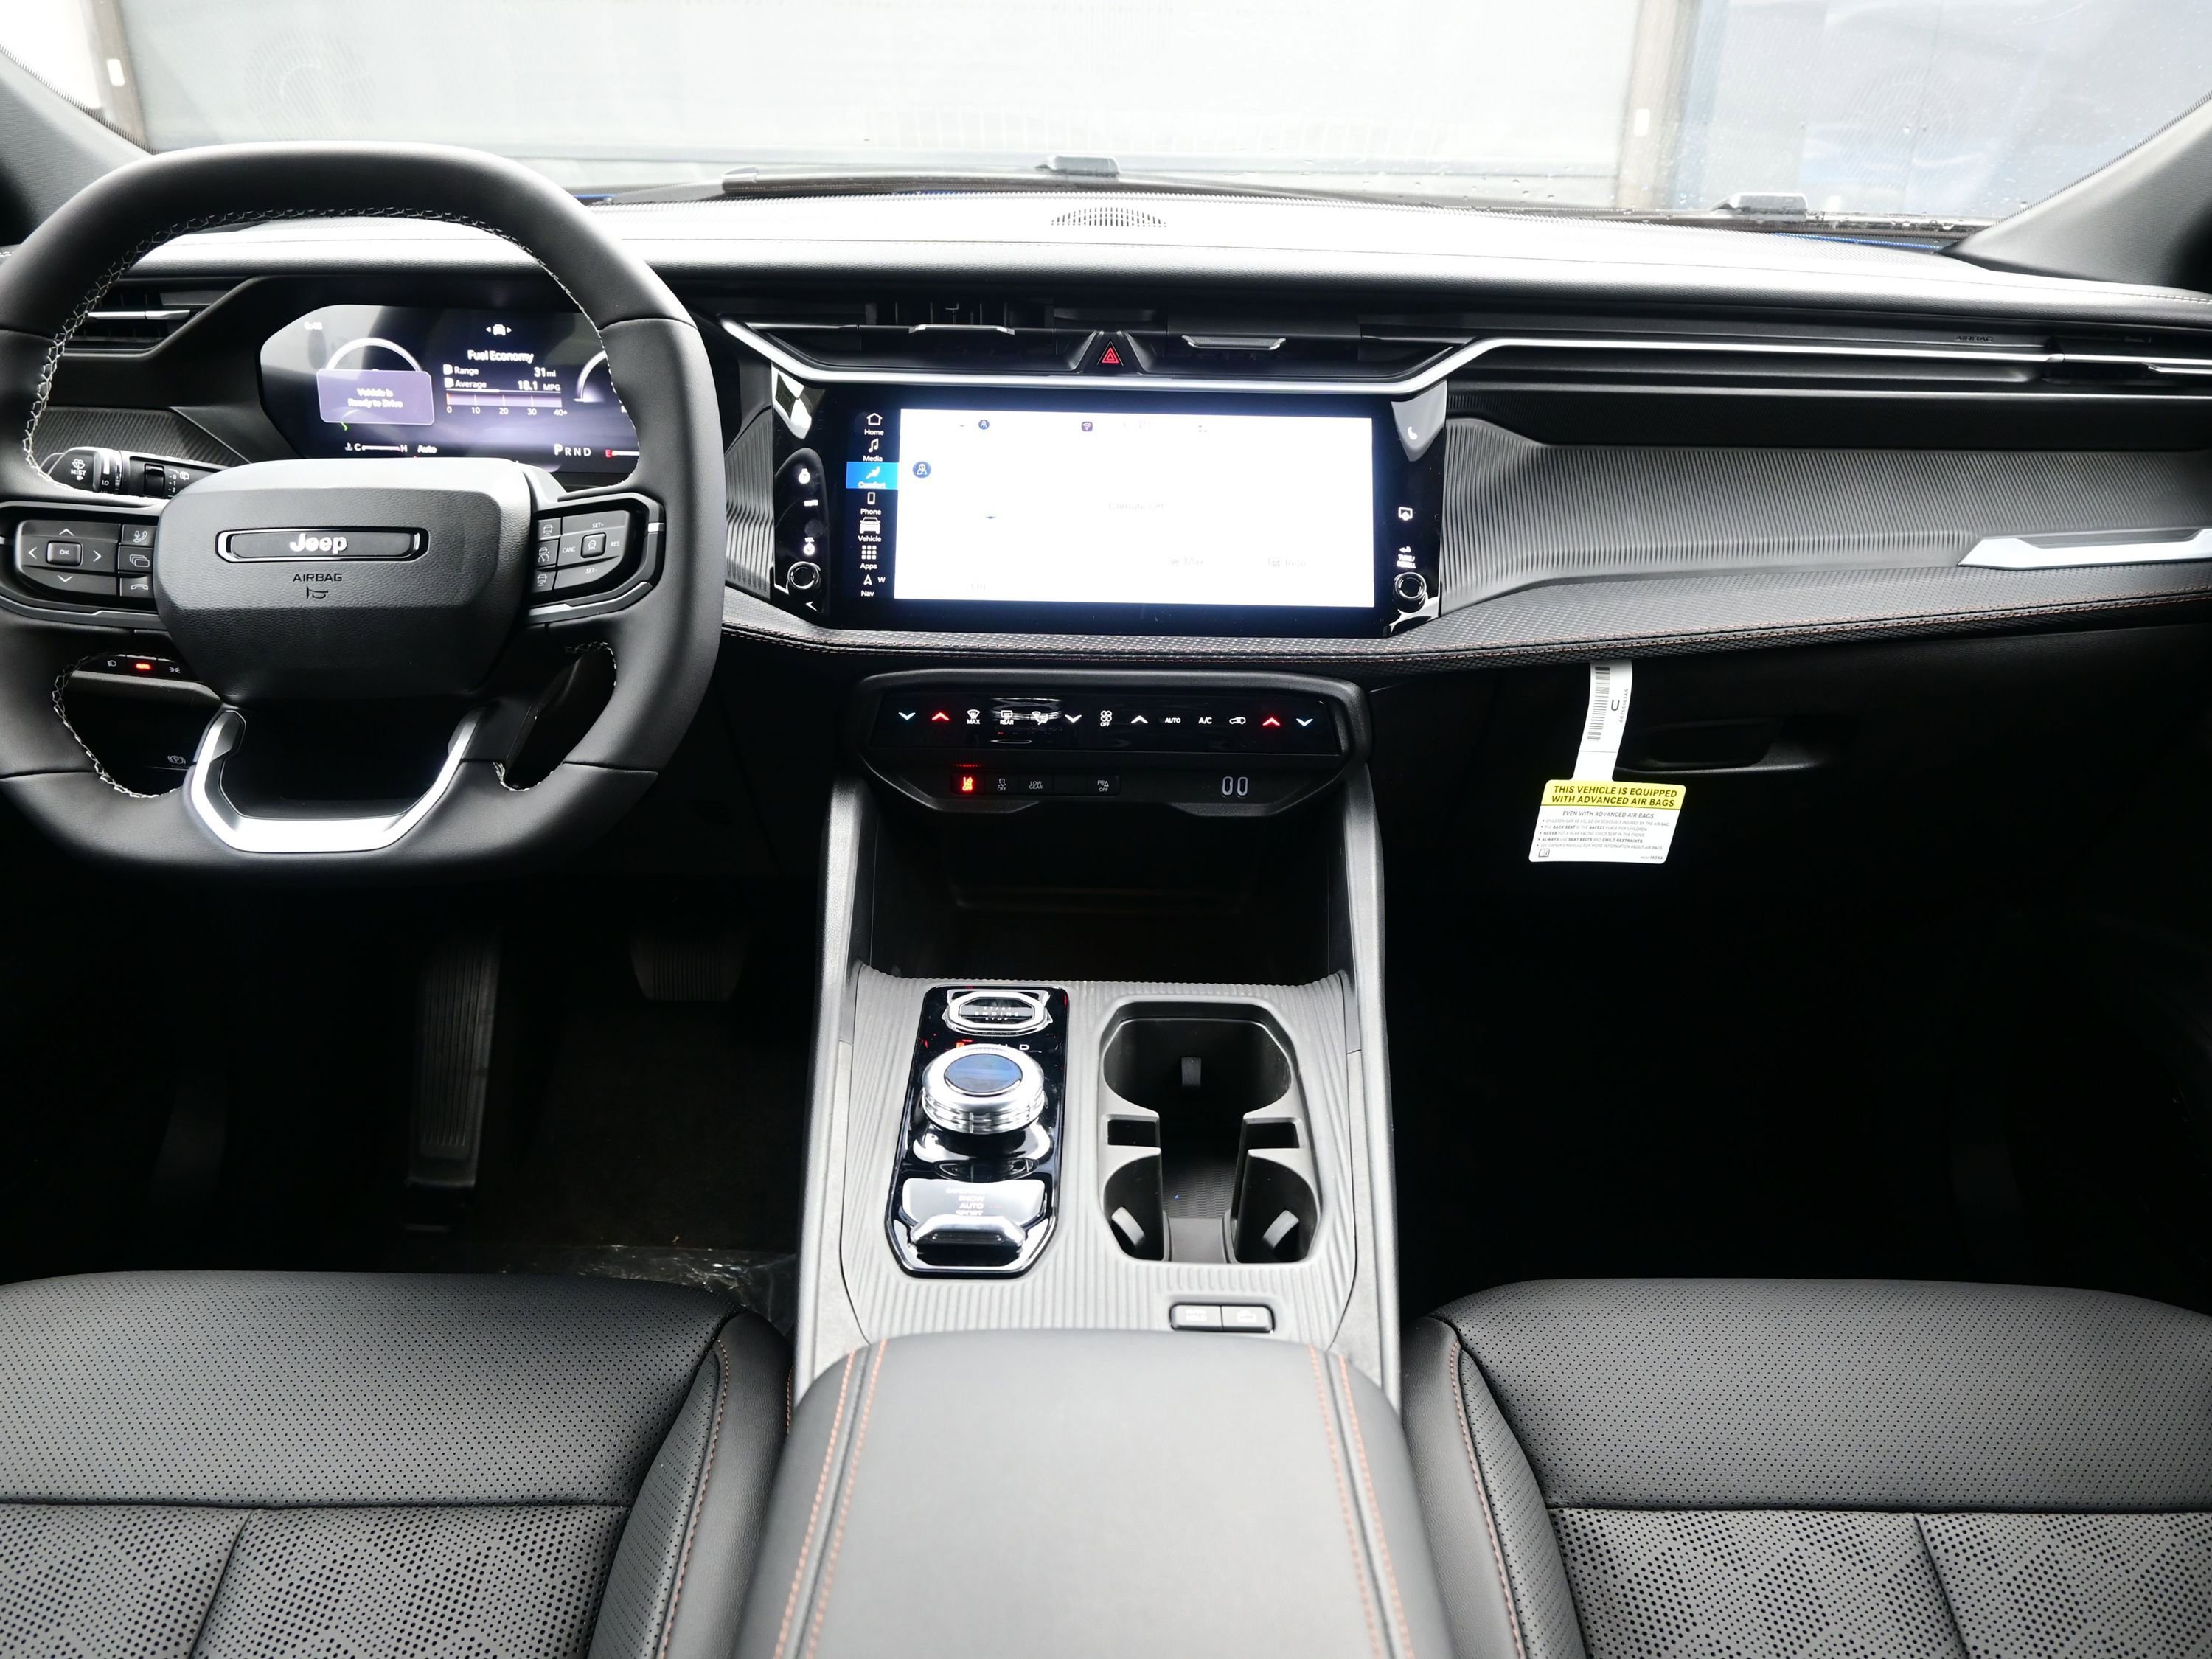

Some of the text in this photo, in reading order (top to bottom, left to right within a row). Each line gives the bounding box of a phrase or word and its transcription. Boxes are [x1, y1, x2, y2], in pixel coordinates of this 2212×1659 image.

[467, 349, 534, 364] Fuel Economy
[454, 366, 479, 376] Range
[534, 367, 546, 378] 31
[456, 380, 487, 389] Average
[357, 388, 394, 397] Vehicle is
[348, 398, 403, 408] Ready to Drive
[354, 443, 361, 451] C
[417, 444, 437, 454] Auto
[554, 443, 591, 457] P R N D
[289, 532, 347, 554] Jeep
[293, 573, 343, 582] AIRBAG
[1610, 699, 1620, 712] U
[1554, 785, 1575, 793] THIS
[1577, 786, 1616, 795] VEHICLE
[1630, 788, 1677, 797] EQUIPPED
[1551, 795, 1576, 803] WITH
[1576, 796, 1629, 804] ADVANCED
[1649, 799, 1674, 807] BAGS
